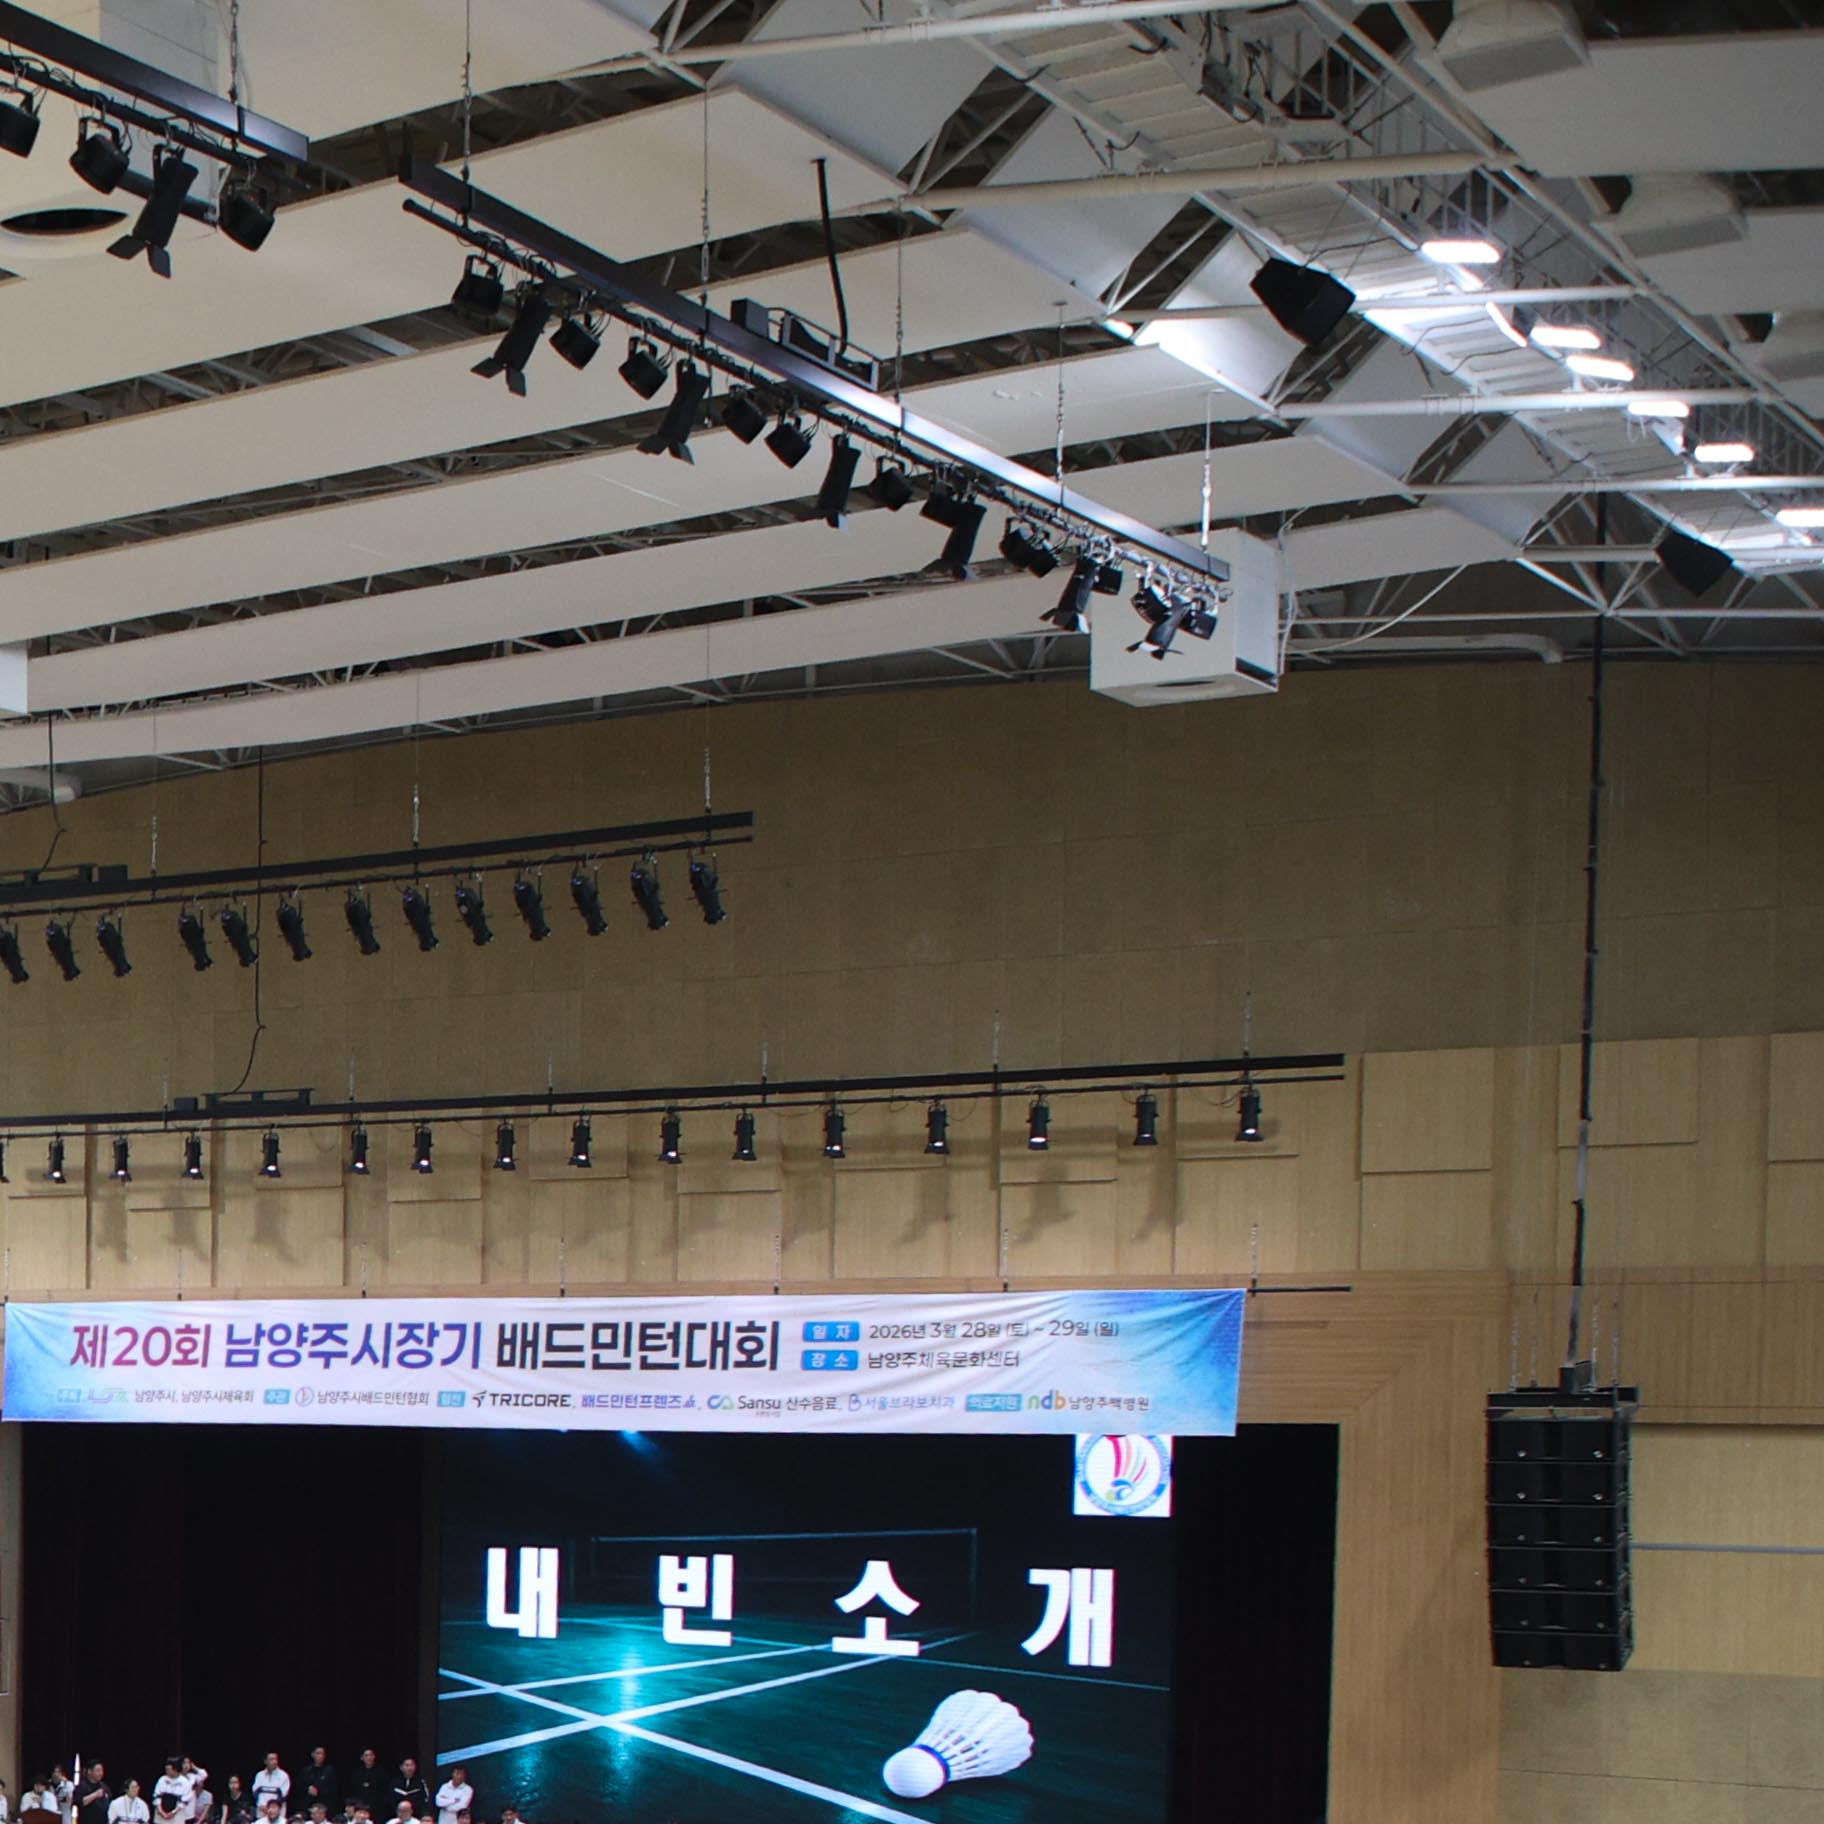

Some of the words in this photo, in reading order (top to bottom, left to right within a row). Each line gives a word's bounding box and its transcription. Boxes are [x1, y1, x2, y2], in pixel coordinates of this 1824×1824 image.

[868, 1322, 926, 1340] 2026년
[929, 1320, 957, 1341] 3월
[961, 1320, 1002, 1340] 28일
[1004, 1321, 1030, 1340] (토)
[1048, 1318, 1090, 1337] 29일
[70, 1322, 212, 1369] 제20회
[224, 1321, 483, 1370] 남양주시장기
[496, 1320, 780, 1371] 배드민턴대회
[867, 1350, 1021, 1369] 남양주체육문화센터
[317, 1391, 430, 1406] 남양주시배드민턴협회
[581, 1393, 684, 1410] 배드민턴프렌즈
[738, 1394, 782, 1411] Sansu
[865, 1395, 956, 1411] 서울브라보치과
[1027, 1389, 1067, 1411] ndb
[485, 1546, 560, 1639] 내
[658, 1553, 736, 1647] 빈
[831, 1559, 921, 1657] 소
[1020, 1567, 1116, 1668] 개
